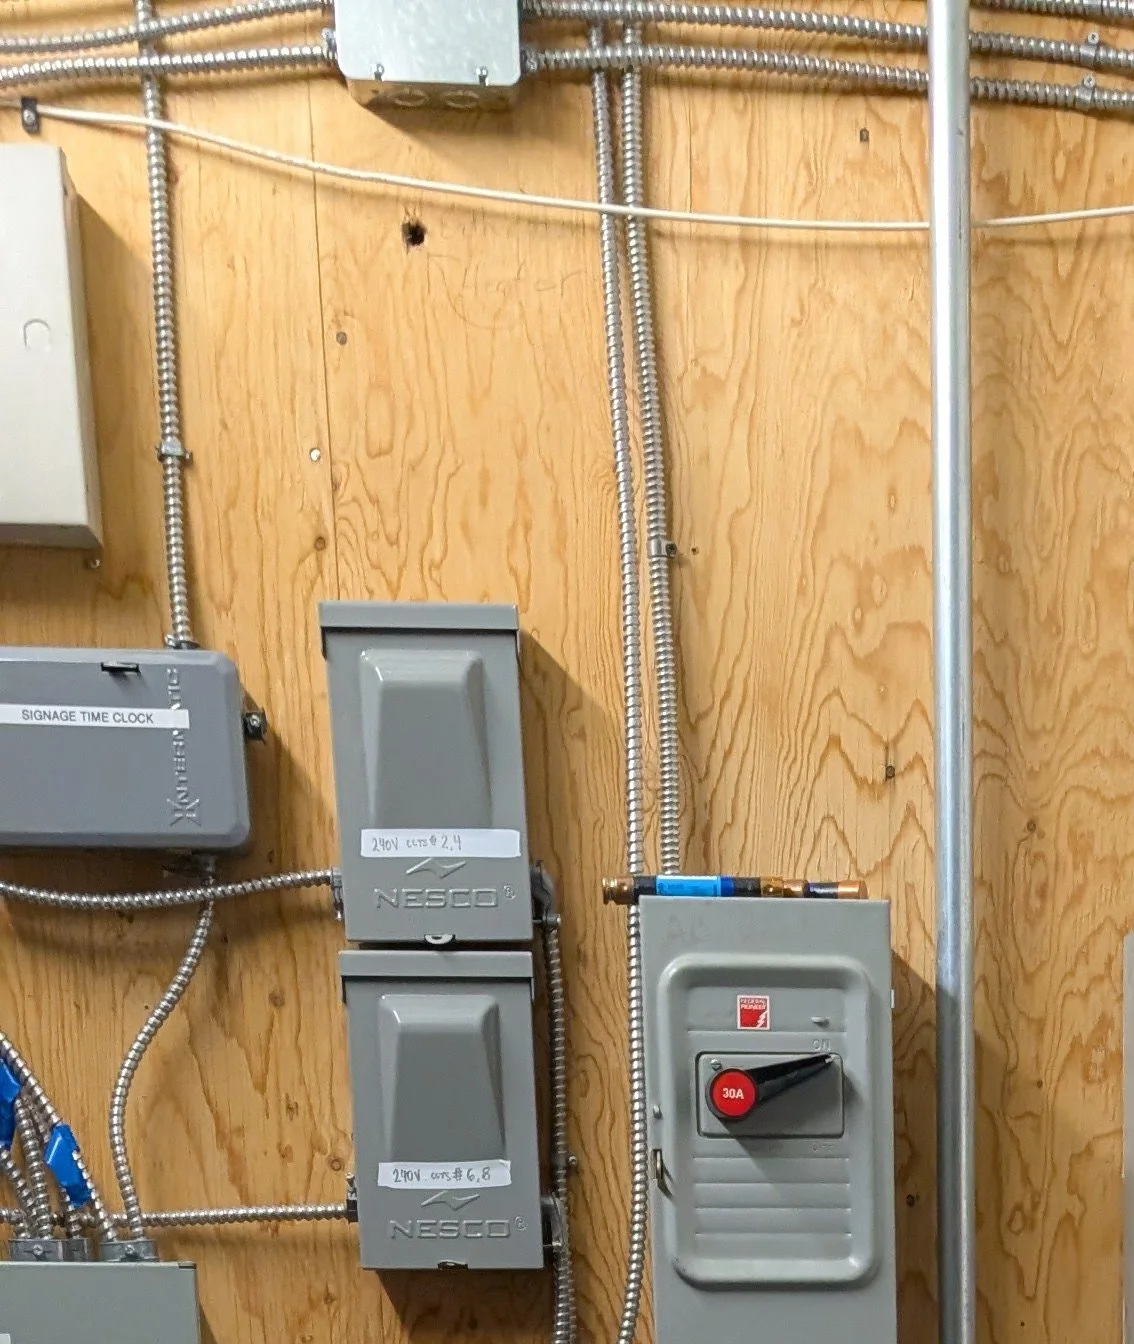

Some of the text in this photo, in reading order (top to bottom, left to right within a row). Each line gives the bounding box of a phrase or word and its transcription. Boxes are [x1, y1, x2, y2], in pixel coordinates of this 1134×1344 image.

[21, 709, 154, 724] SIGNAGE TIME CLOCK
[372, 837, 398, 852] 240V
[373, 888, 499, 909] NESCO
[722, 1087, 745, 1100] 30A
[392, 1167, 421, 1183] 240V
[389, 1219, 511, 1239] NESCO
